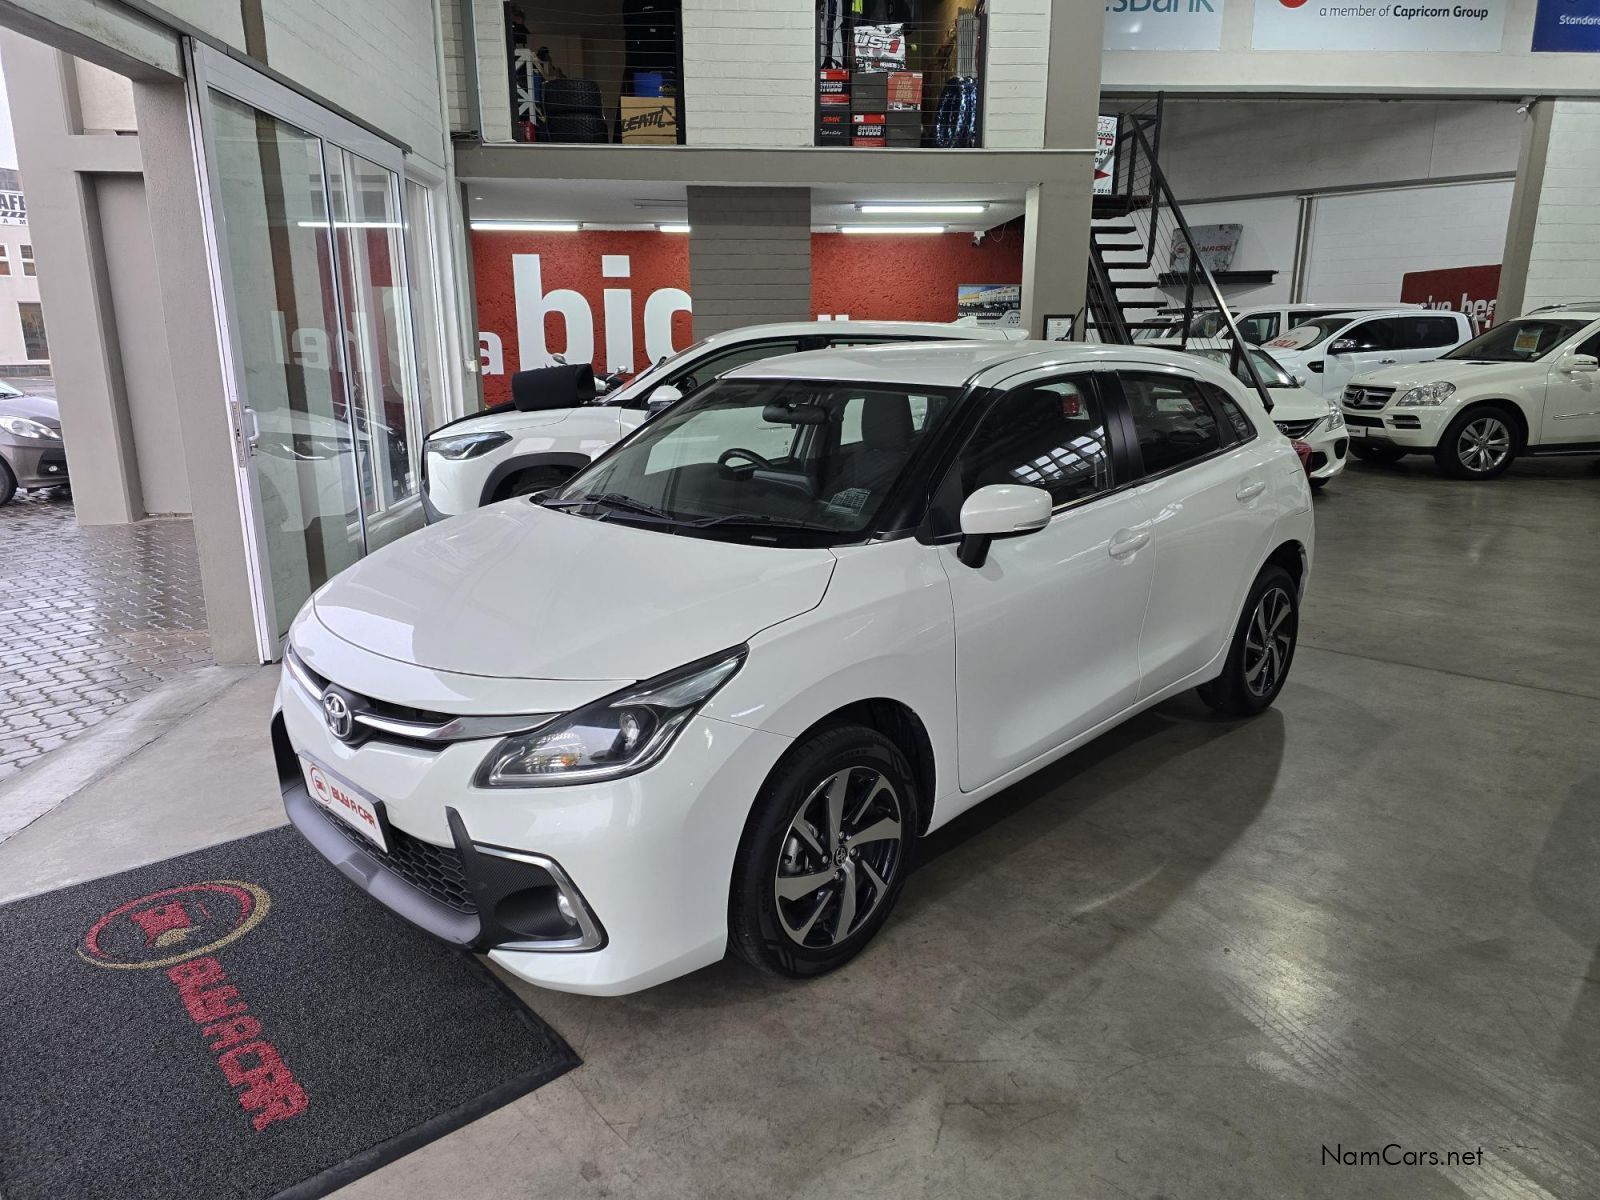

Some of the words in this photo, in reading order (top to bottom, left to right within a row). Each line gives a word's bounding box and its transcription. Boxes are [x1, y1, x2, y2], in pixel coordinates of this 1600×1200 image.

[1319, 7, 1327, 17] a
[1330, 5, 1375, 17] member
[1378, 5, 1391, 17] of
[1393, 5, 1450, 20] Capricorn
[1453, 5, 1489, 21] Group
[857, 125, 882, 136] STUDDS
[357, 804, 377, 830] CAR
[218, 1040, 311, 1132] CAR
